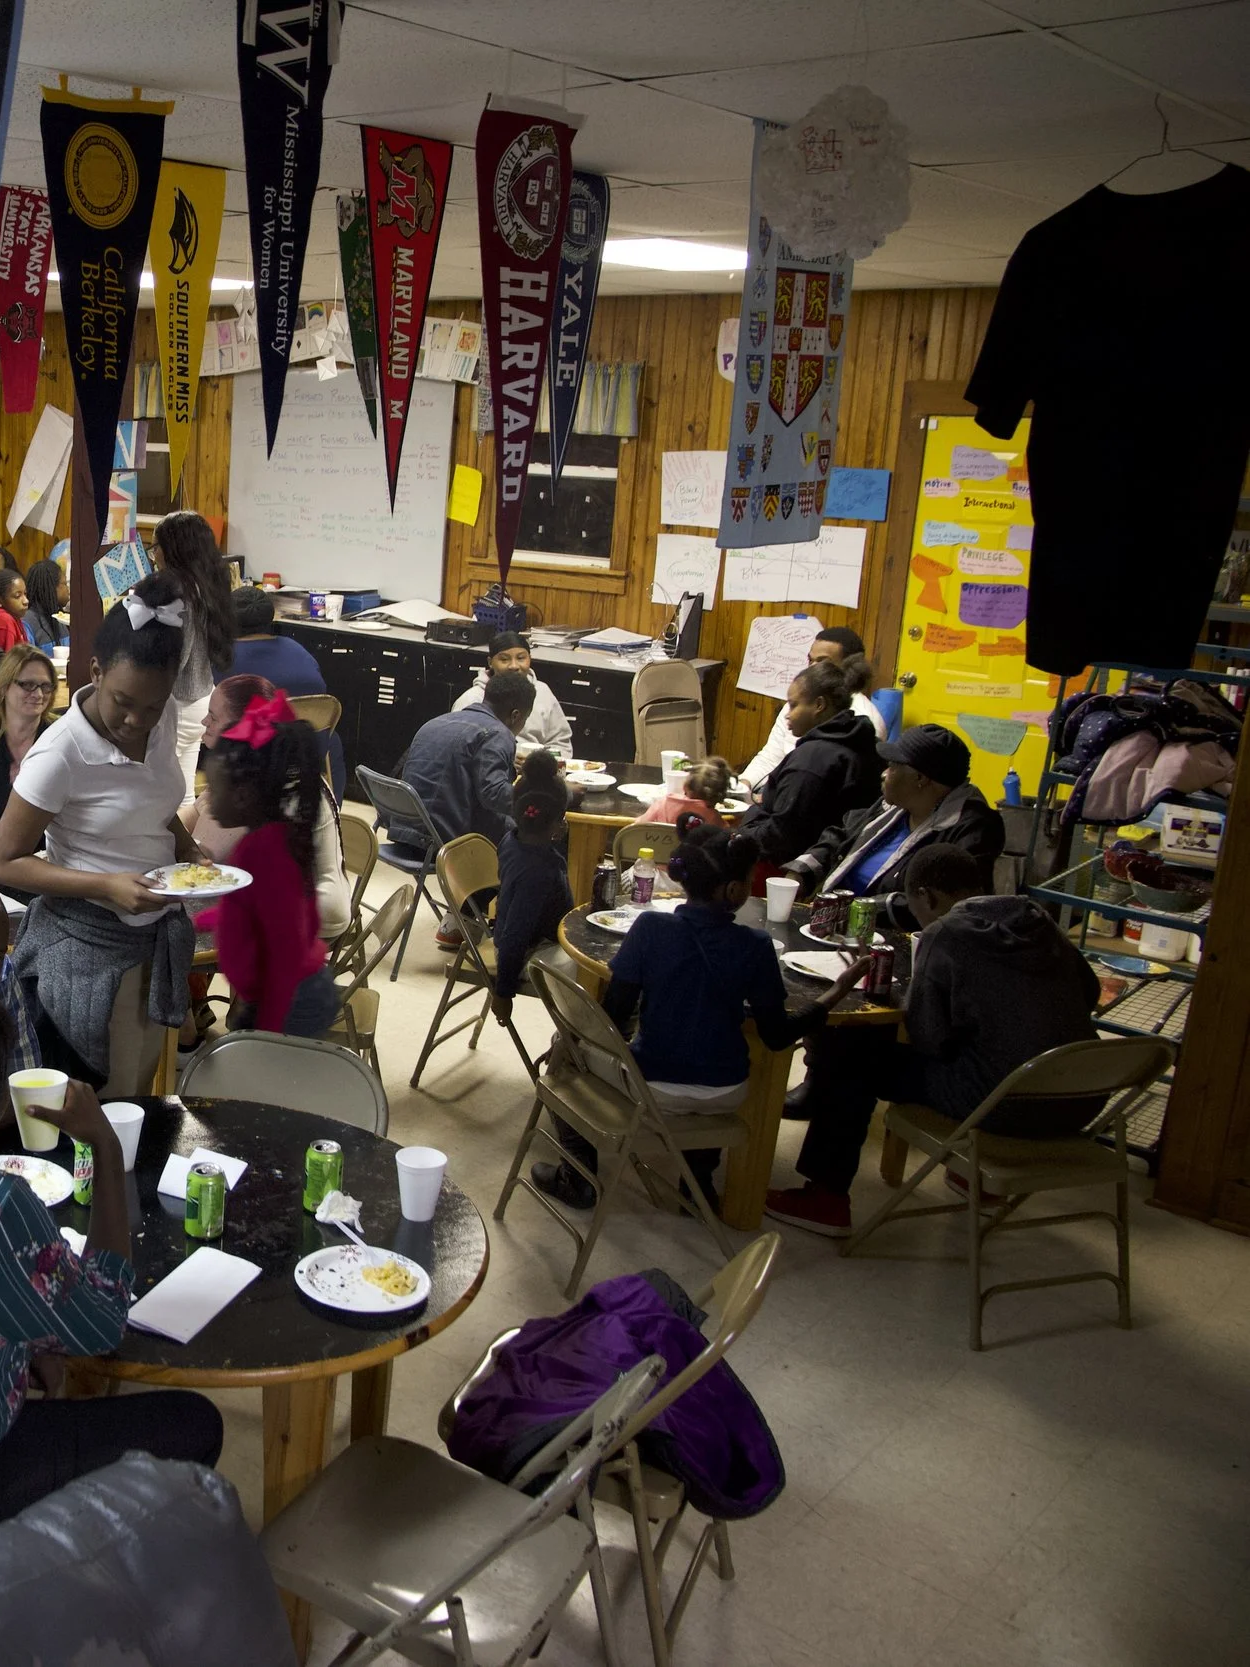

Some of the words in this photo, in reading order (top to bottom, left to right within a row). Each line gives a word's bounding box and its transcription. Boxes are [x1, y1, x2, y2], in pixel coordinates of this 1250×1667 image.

[263, 185, 275, 214] for
[279, 104, 299, 235] Mississippi
[496, 152, 519, 227] HARVARD
[16, 197, 35, 246] STATE
[25, 200, 52, 297] ARKANSAS
[260, 219, 272, 289] Women
[75, 259, 100, 372] Berkeley
[102, 246, 125, 381] California
[168, 292, 176, 340] GOLDEN
[175, 280, 190, 367] SOUTHERN
[271, 241, 296, 357] University
[391, 247, 415, 379] MARYLAND
[554, 272, 582, 389] YALE
[167, 348, 175, 411] EAGLES
[175, 371, 190, 424] MISS
[390, 400, 403, 419] M
[499, 267, 549, 501] HARVARD
